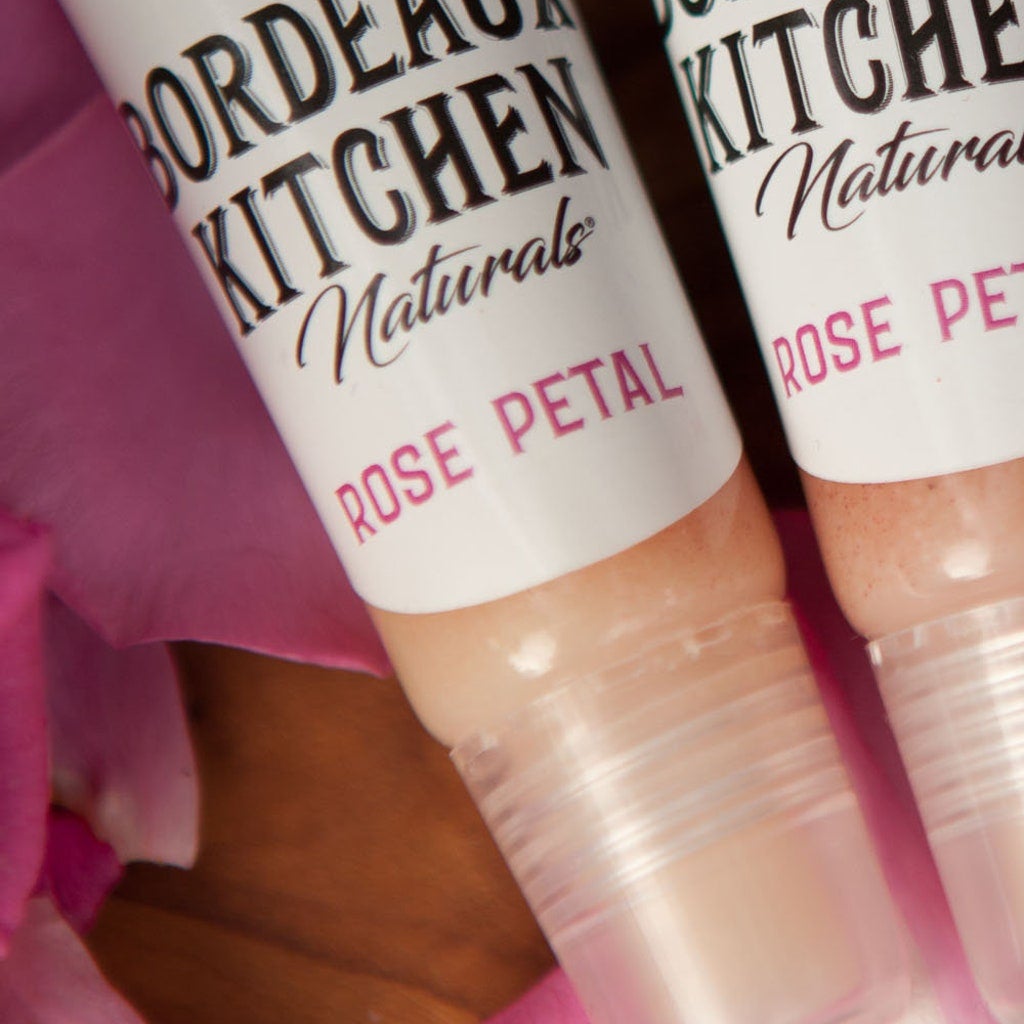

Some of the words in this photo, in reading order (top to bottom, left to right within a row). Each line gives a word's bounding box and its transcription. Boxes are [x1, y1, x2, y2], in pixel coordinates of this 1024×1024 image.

[191, 57, 610, 338] KITCHEN
[335, 421, 474, 546] ROSE
[491, 343, 685, 455] PETAL
[772, 295, 902, 399] ROSE
